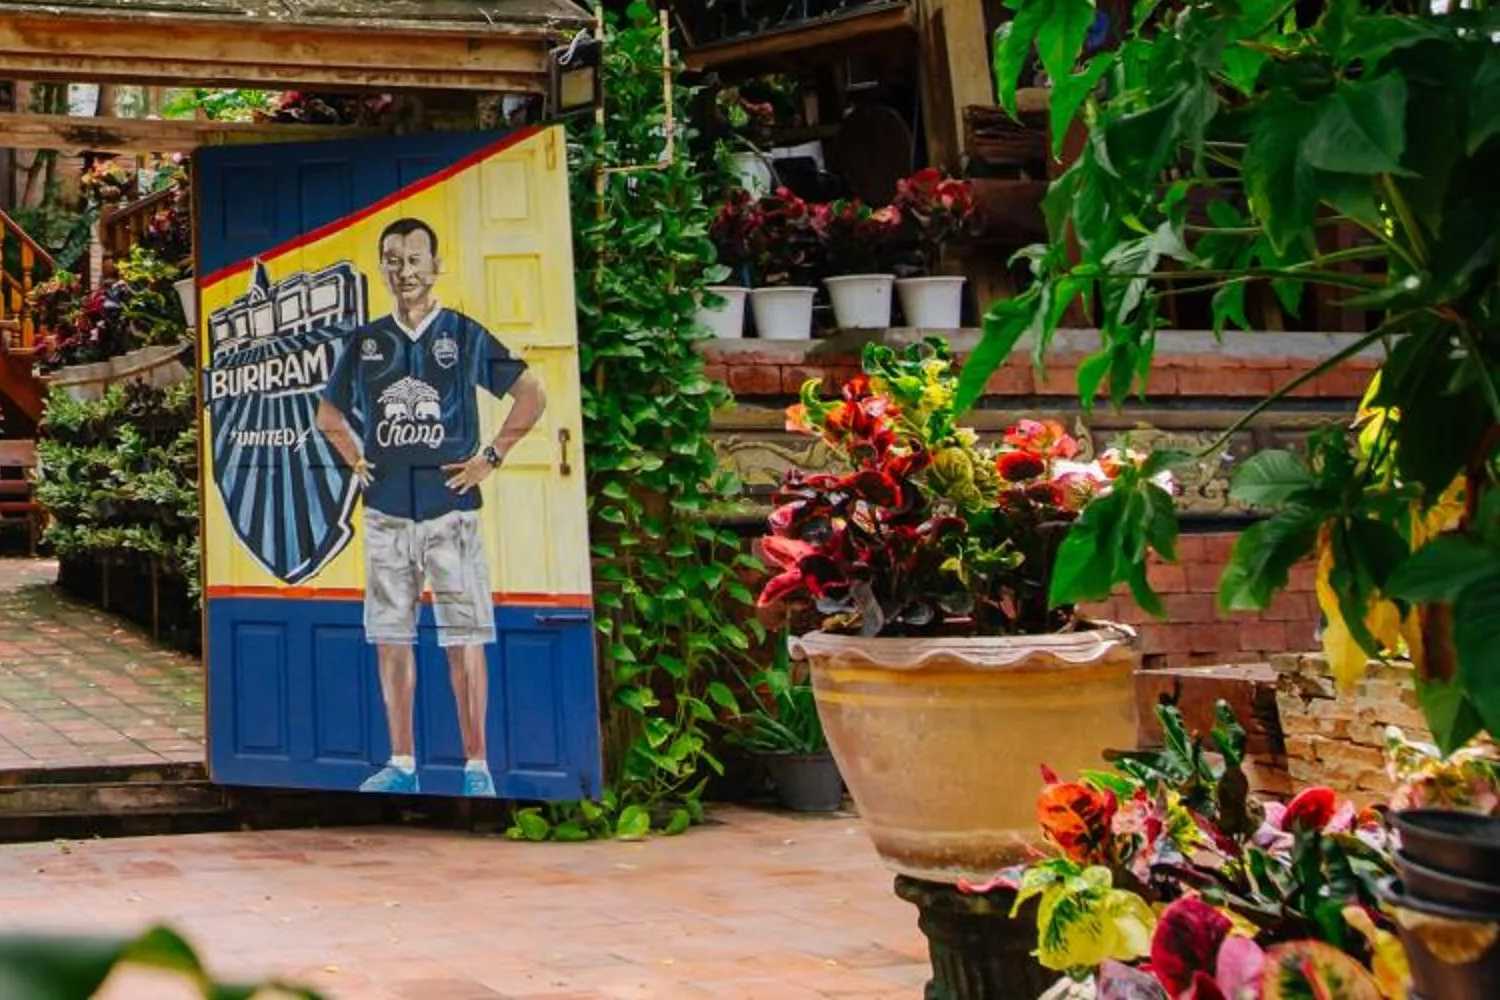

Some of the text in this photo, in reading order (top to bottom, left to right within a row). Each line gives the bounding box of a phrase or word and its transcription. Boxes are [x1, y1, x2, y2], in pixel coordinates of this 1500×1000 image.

[211, 343, 329, 399] BURIRAM
[237, 427, 296, 446] UNITED
[377, 420, 445, 449] Chang
